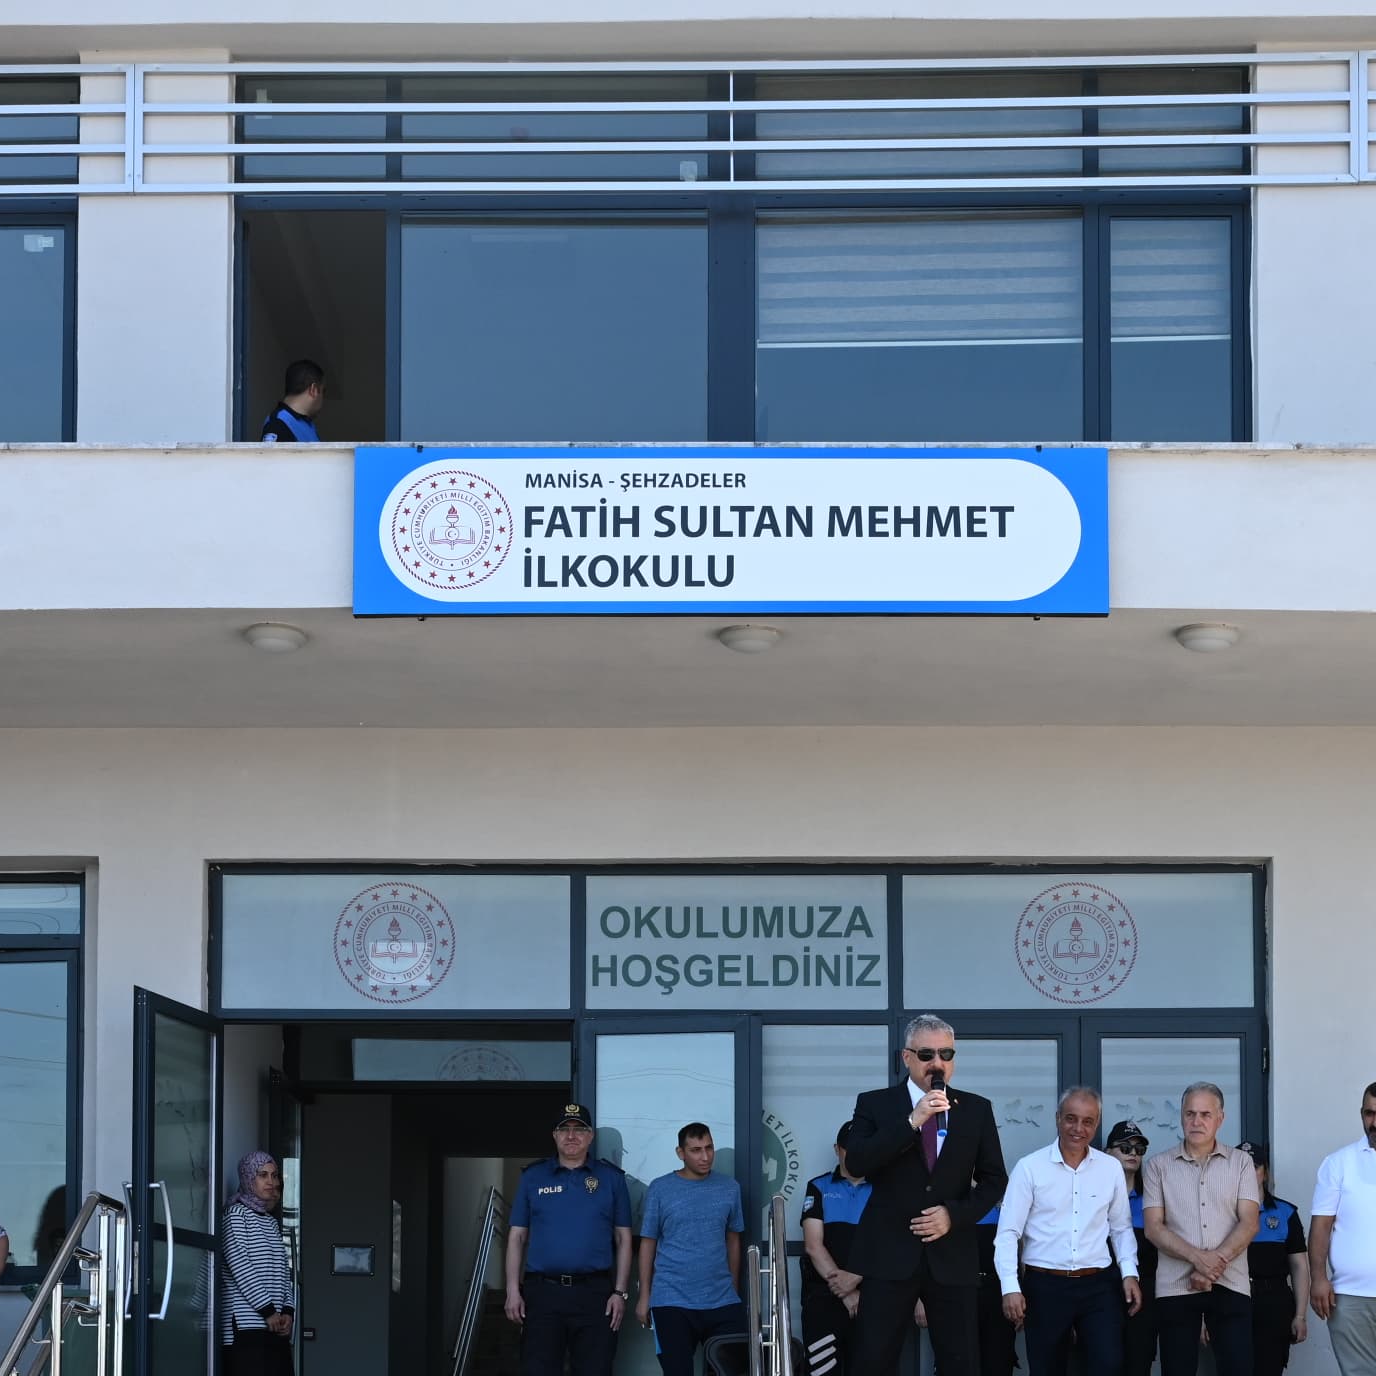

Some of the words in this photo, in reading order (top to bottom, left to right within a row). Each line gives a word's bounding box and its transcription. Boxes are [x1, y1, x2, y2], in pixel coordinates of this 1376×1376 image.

[450, 491, 473, 503] MİLLİ
[525, 469, 604, 489] MANİSA
[620, 472, 746, 493] ŞEHZADELER
[524, 497, 640, 538] FATİH
[653, 505, 813, 538] SULTAN
[827, 505, 1015, 538] MEHMET
[523, 547, 735, 588] İLKOKULU
[599, 905, 875, 940] OKULUMUZA
[591, 945, 882, 996] HOŞGELDİNİZ
[538, 1185, 563, 1195] POLİS
